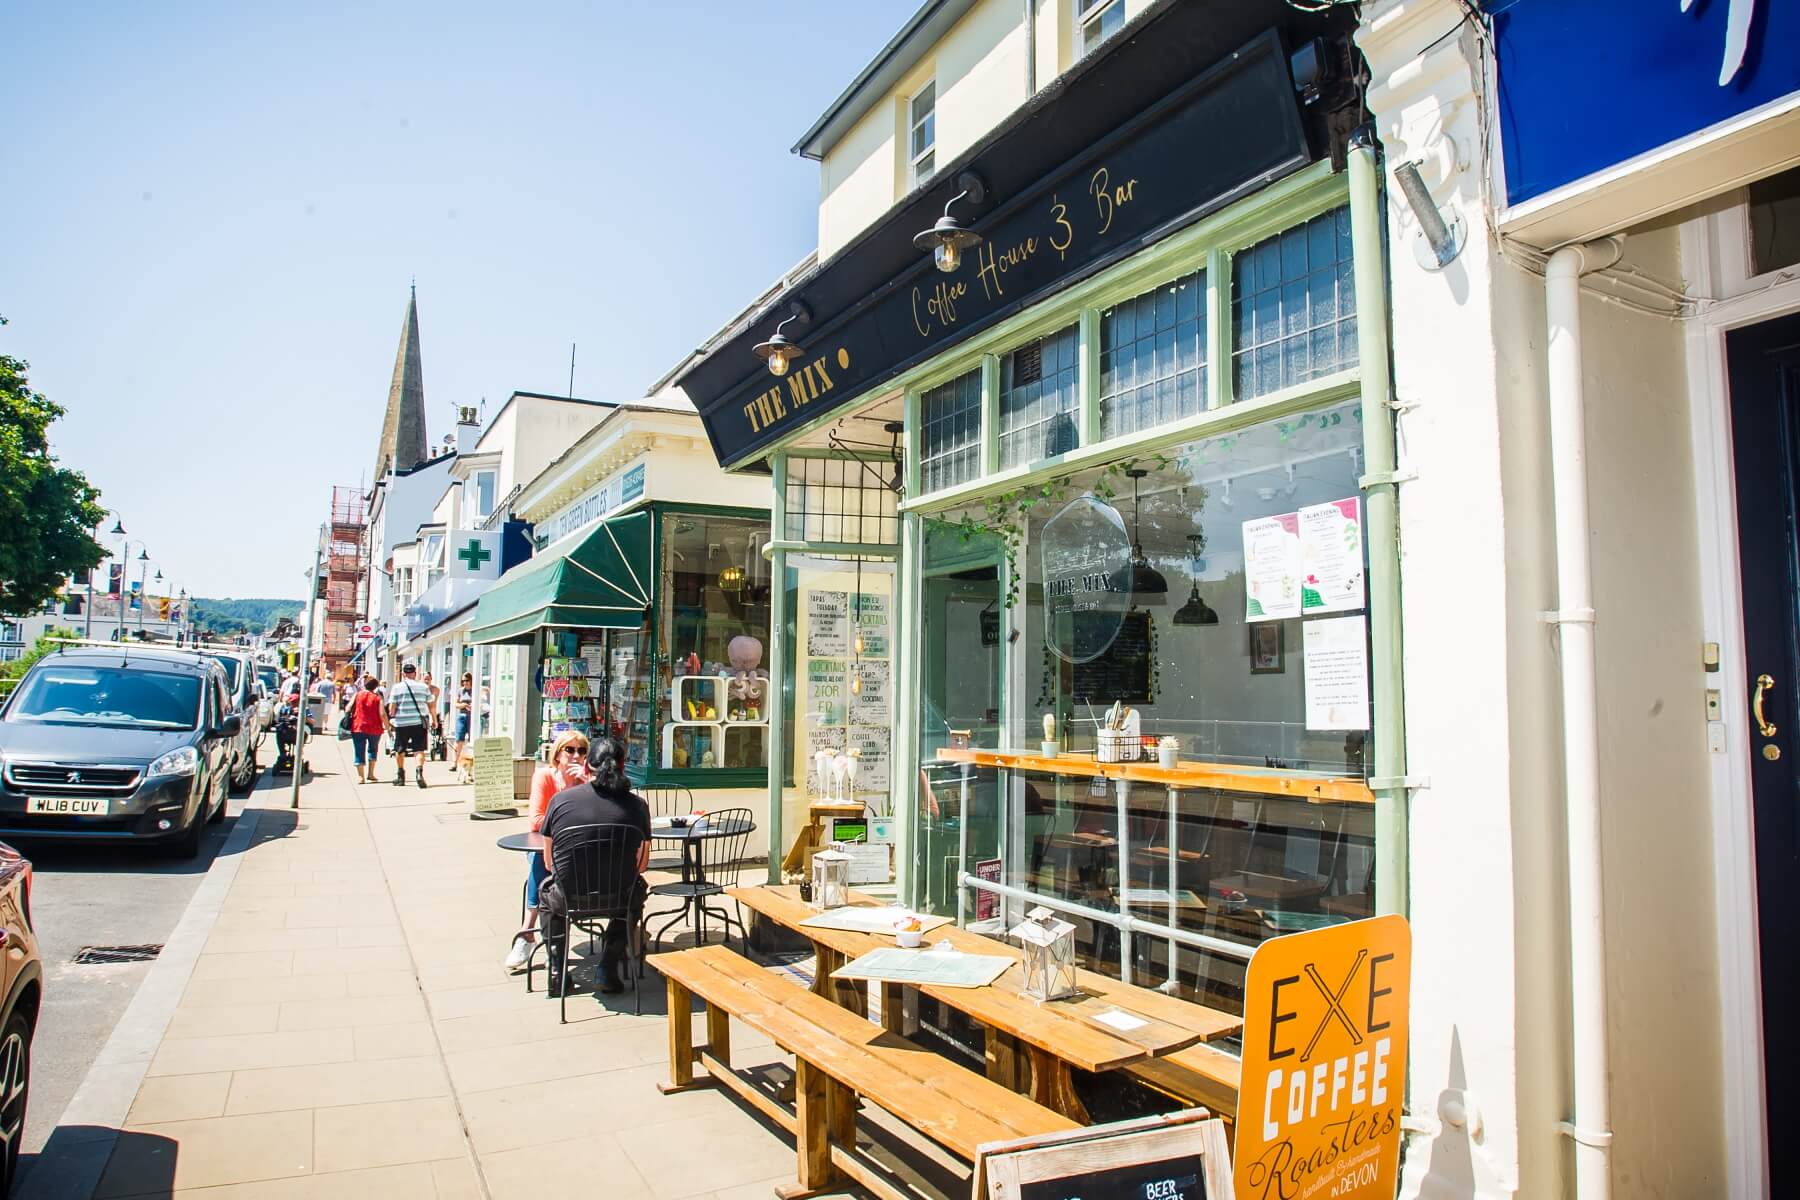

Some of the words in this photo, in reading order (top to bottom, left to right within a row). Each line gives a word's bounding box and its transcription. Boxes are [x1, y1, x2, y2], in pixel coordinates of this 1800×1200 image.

[744, 379, 787, 433] THE
[787, 355, 834, 408] MIX
[911, 278, 967, 337] Coffee
[977, 234, 1039, 302] House
[1089, 166, 1139, 235] Bar
[567, 505, 583, 534] GREEN
[584, 487, 608, 524] BOTTLES
[810, 595, 825, 603] TAPAS
[1049, 577, 1075, 597] THE
[1082, 570, 1110, 592] MIX
[816, 603, 838, 611] TUESDAY
[36, 799, 68, 812] WL18
[71, 801, 99, 812] CUV
[980, 864, 1001, 873] UNDER
[1268, 948, 1395, 1063] EXE
[1262, 1037, 1391, 1142] COFFEE
[1247, 1108, 1395, 1200] Roasters
[1146, 1179, 1176, 1199] BEER
[1331, 1183, 1339, 1198] IN
[1340, 1158, 1380, 1195] DEVON
